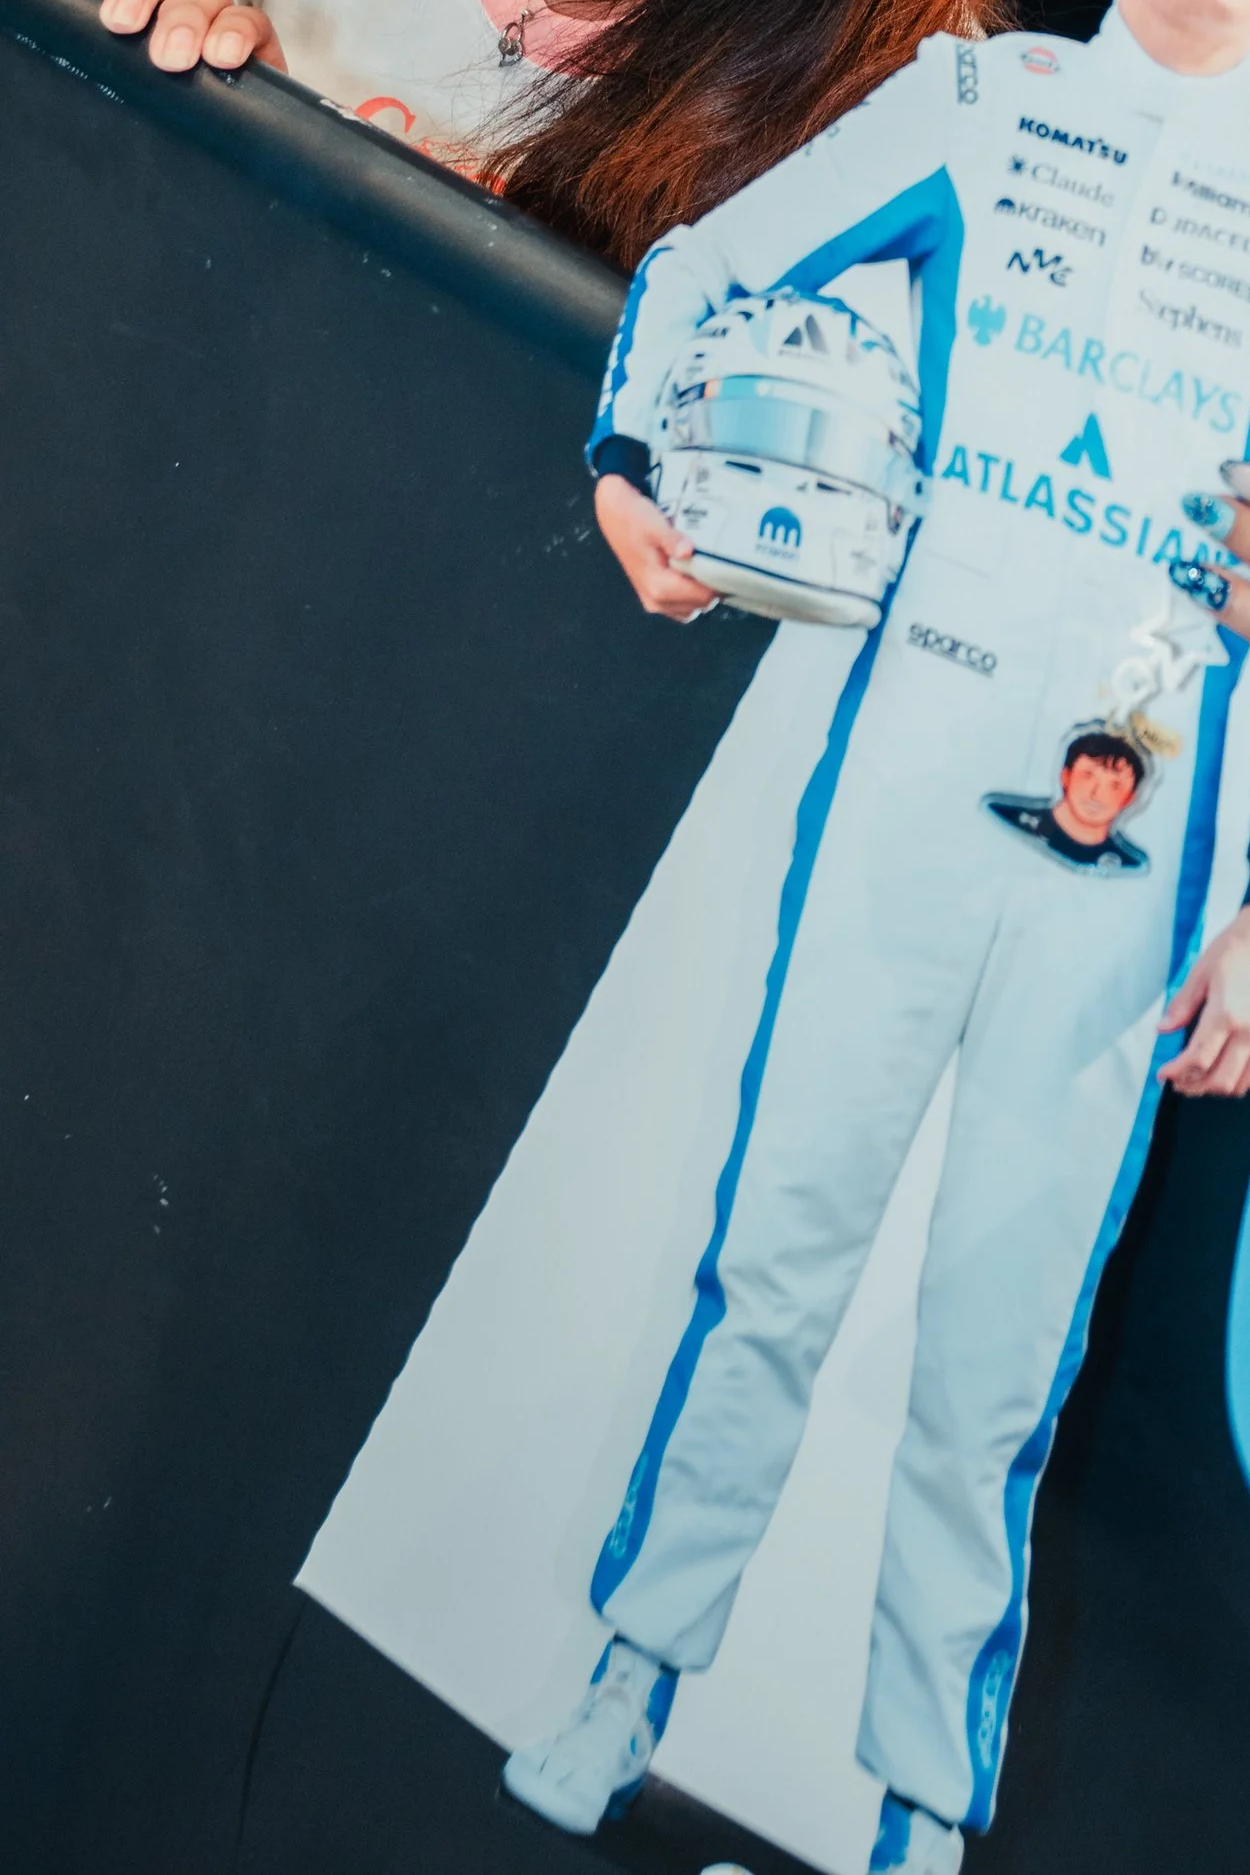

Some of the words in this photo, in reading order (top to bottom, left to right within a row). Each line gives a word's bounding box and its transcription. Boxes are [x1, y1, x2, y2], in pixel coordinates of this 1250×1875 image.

[1018, 116, 1128, 165] KOMATSU
[1031, 163, 1116, 208] Claude
[1013, 313, 1242, 433] BARCLAYS
[905, 622, 1000, 677] sparco
